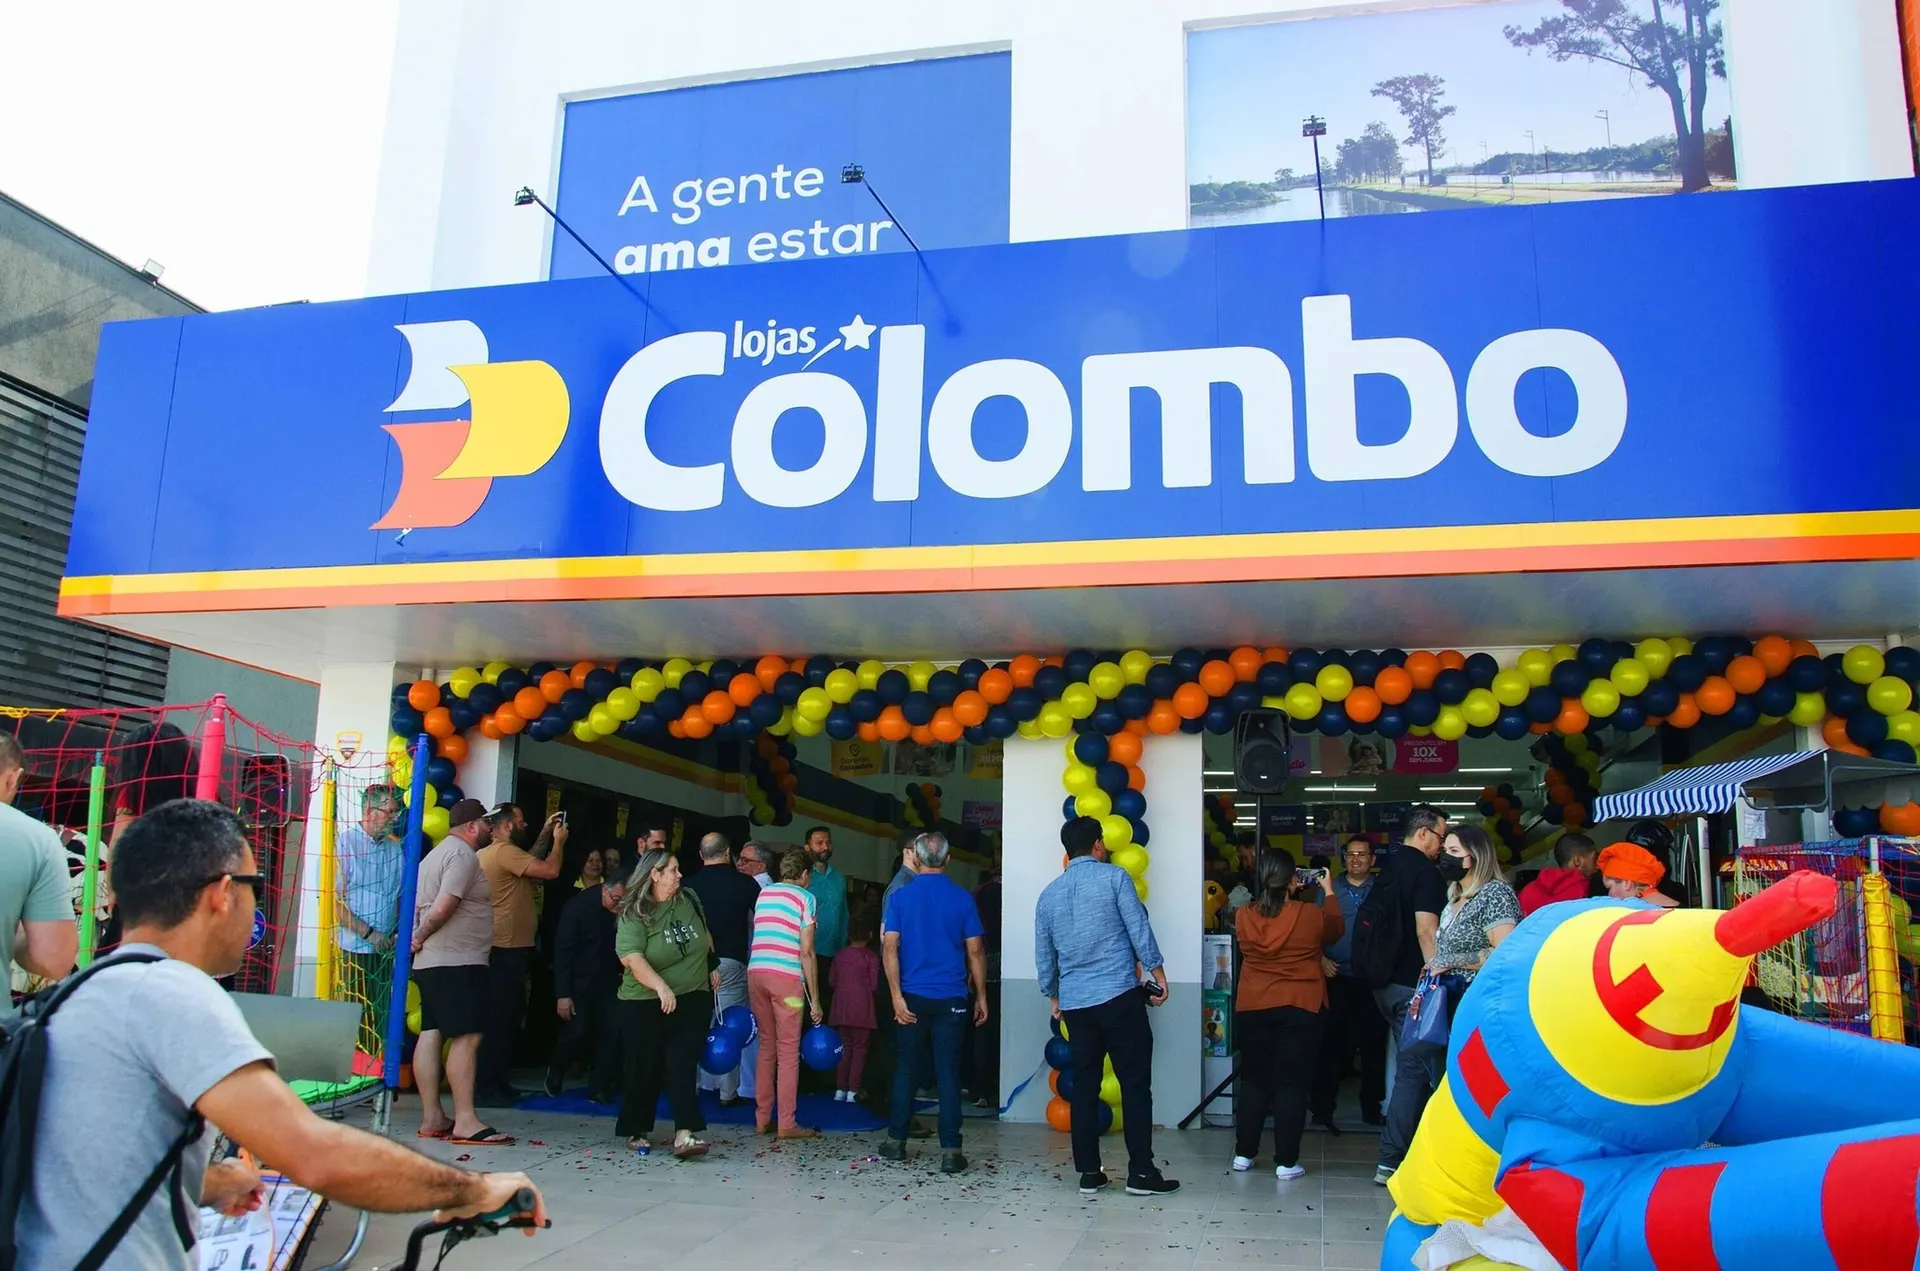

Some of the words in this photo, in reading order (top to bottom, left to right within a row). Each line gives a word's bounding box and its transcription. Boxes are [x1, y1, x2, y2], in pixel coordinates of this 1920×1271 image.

[617, 175, 658, 216] A
[671, 164, 824, 225] gente
[614, 236, 731, 275] ama
[747, 220, 893, 262] estar
[733, 320, 816, 366] lojas
[599, 294, 1628, 511] Colombo
[1412, 746, 1438, 757] 10X
